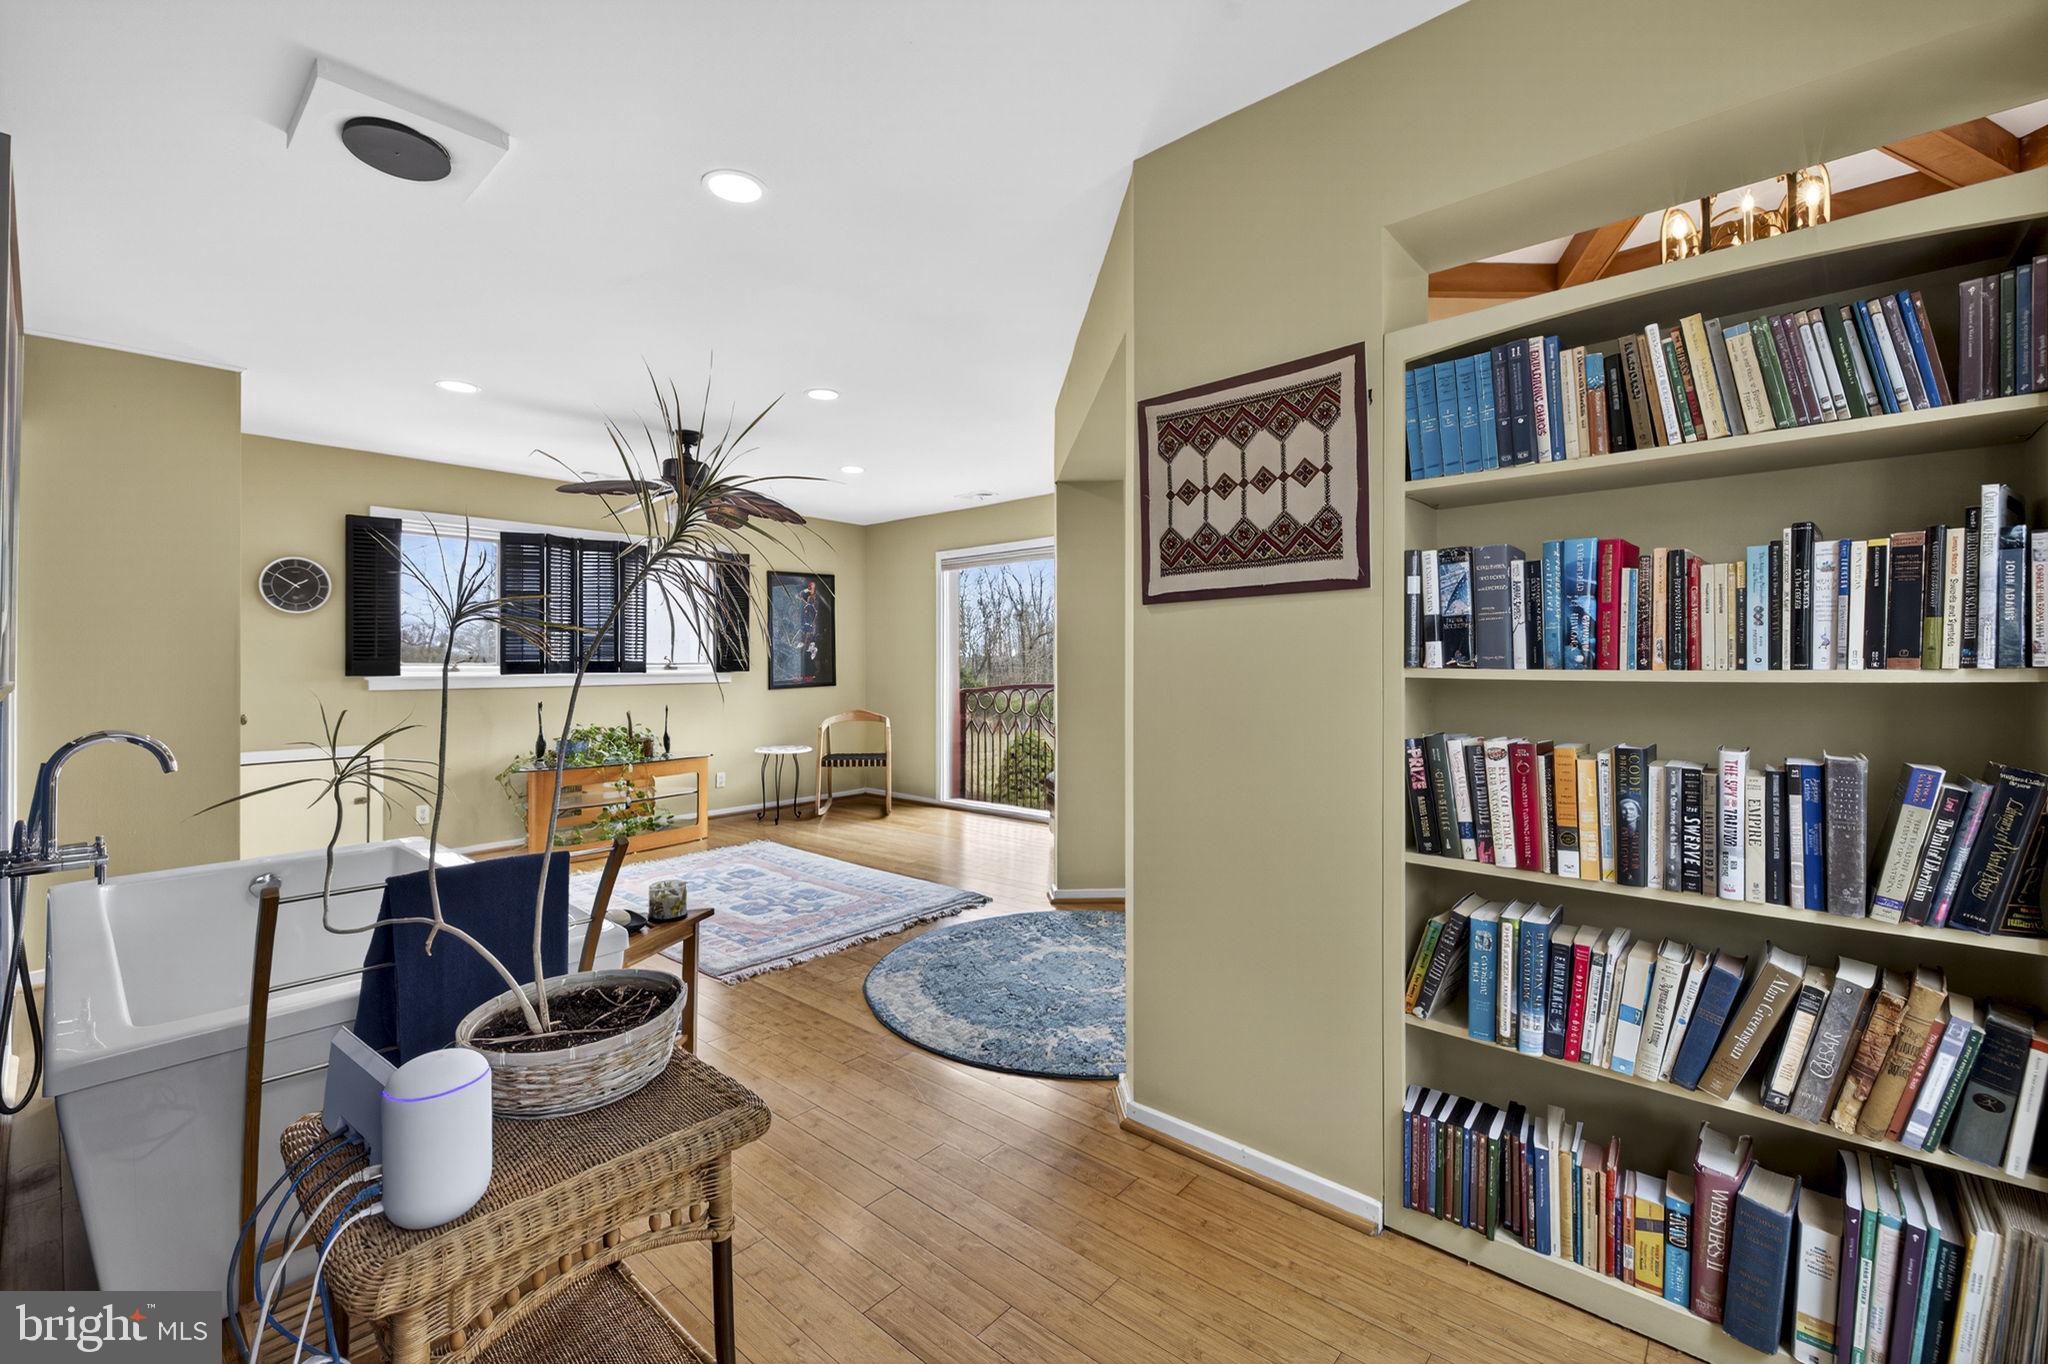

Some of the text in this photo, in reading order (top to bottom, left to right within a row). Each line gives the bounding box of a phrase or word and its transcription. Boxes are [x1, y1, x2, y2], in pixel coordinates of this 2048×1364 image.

[1534, 403, 1547, 436] CHAOS
[1948, 577, 1959, 602] Swords
[1948, 604, 1957, 616] and
[2004, 559, 2015, 620] JOHN ADAMS
[1946, 618, 1956, 646] Symbols
[1407, 747, 1426, 790] PRIZE
[1488, 766, 1497, 786] BOB
[1628, 754, 1640, 798] CODE
[1723, 760, 1737, 797] THE SPY
[1498, 766, 1512, 849] PLAN OF ATTACK
[1723, 809, 1737, 846] TRAITOR
[1747, 799, 1761, 846] EMPIRE
[1935, 816, 1953, 835] The
[1683, 816, 1701, 865] SWERVE
[1971, 797, 2024, 901] Library of World Poetry
[1534, 932, 1543, 990] HAMPTON
[1551, 955, 1565, 1015] ENDURANCE
[1730, 973, 1791, 1062] Alan Greenspan
[1810, 1032, 1842, 1079] CAESAR
[1705, 1259, 1724, 1273] II
